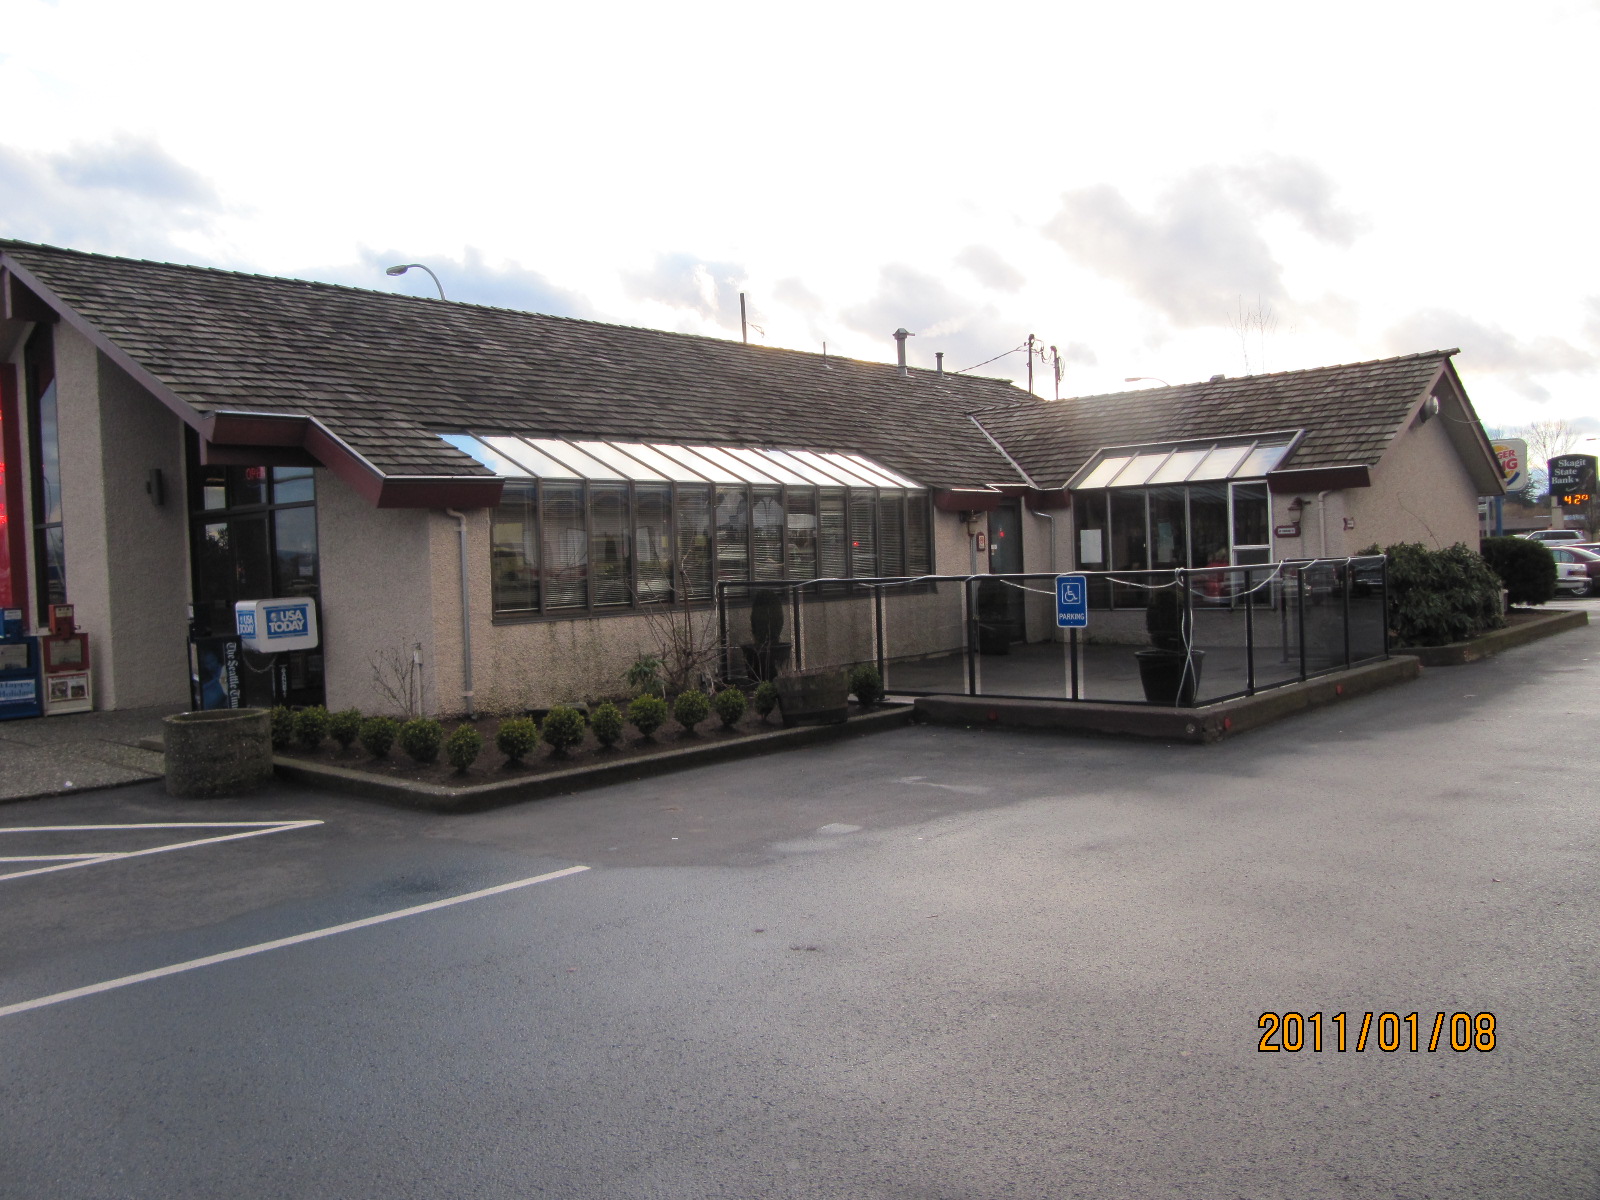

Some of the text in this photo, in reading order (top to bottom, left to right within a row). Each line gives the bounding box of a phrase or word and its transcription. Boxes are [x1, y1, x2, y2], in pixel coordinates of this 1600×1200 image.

[1496, 449, 1516, 459] GER
[1558, 459, 1586, 468] Skagit
[1554, 468, 1578, 476] State
[1551, 476, 1574, 485] Bank
[280, 609, 304, 621] USA
[268, 619, 305, 633] TODAY
[226, 642, 237, 659] The
[227, 660, 240, 689] Seattle
